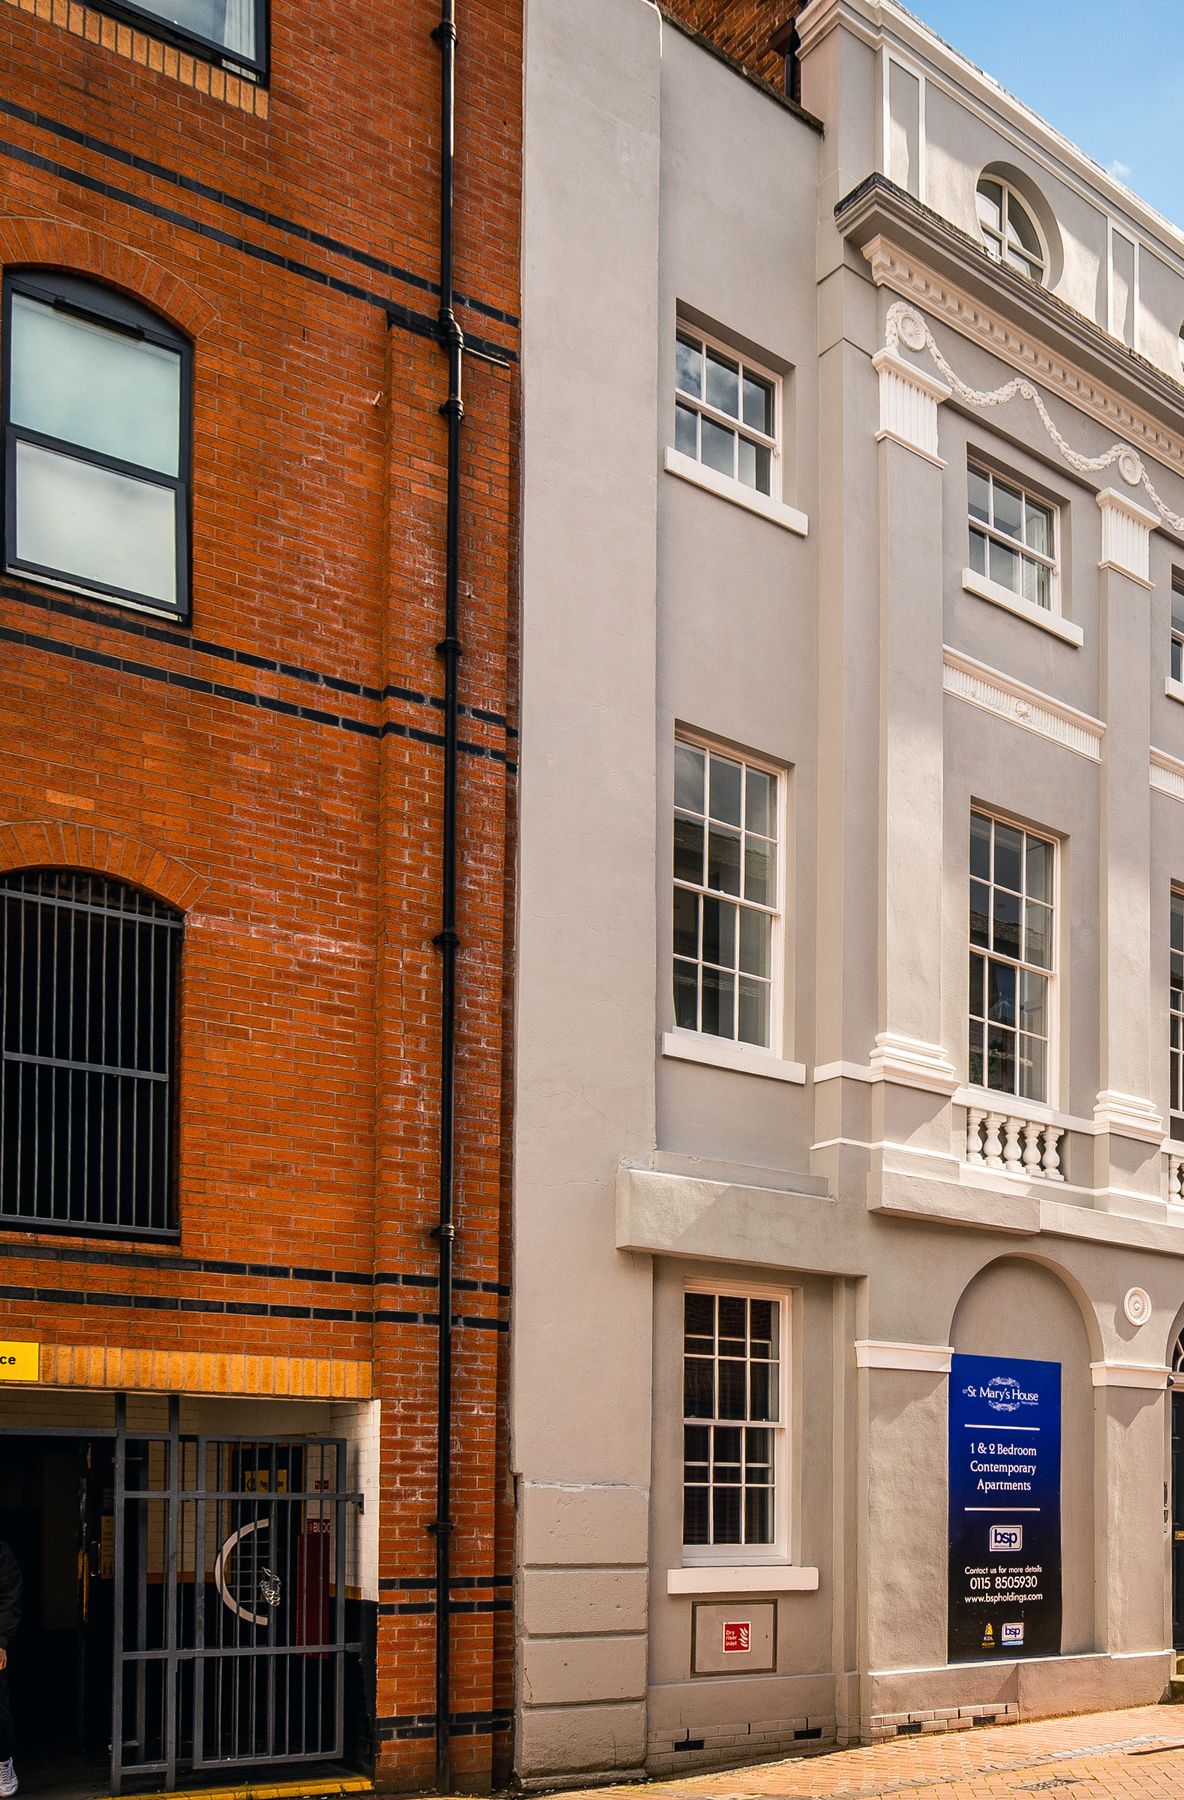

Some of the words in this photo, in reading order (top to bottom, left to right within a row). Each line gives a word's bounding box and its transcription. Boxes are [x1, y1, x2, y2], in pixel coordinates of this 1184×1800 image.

[967, 1385, 977, 1397] St
[979, 1386, 1010, 1402] Mary's
[1012, 1389, 1039, 1401] House
[970, 1442, 975, 1454] 1
[977, 1442, 987, 1454] &
[988, 1443, 996, 1454] 2
[997, 1443, 1037, 1456] Bedroom
[970, 1460, 1037, 1477] Contemporary
[977, 1478, 1031, 1494] Apartments
[994, 1529, 1017, 1547] bsp
[964, 1566, 988, 1574] Contact
[998, 1565, 1007, 1573] for
[1024, 1565, 1042, 1573] details
[970, 1577, 991, 1590] 0115
[995, 1576, 1038, 1589] 8505930
[964, 1592, 1043, 1604] www.bspholdings.com
[1005, 1627, 1020, 1637] bsp
